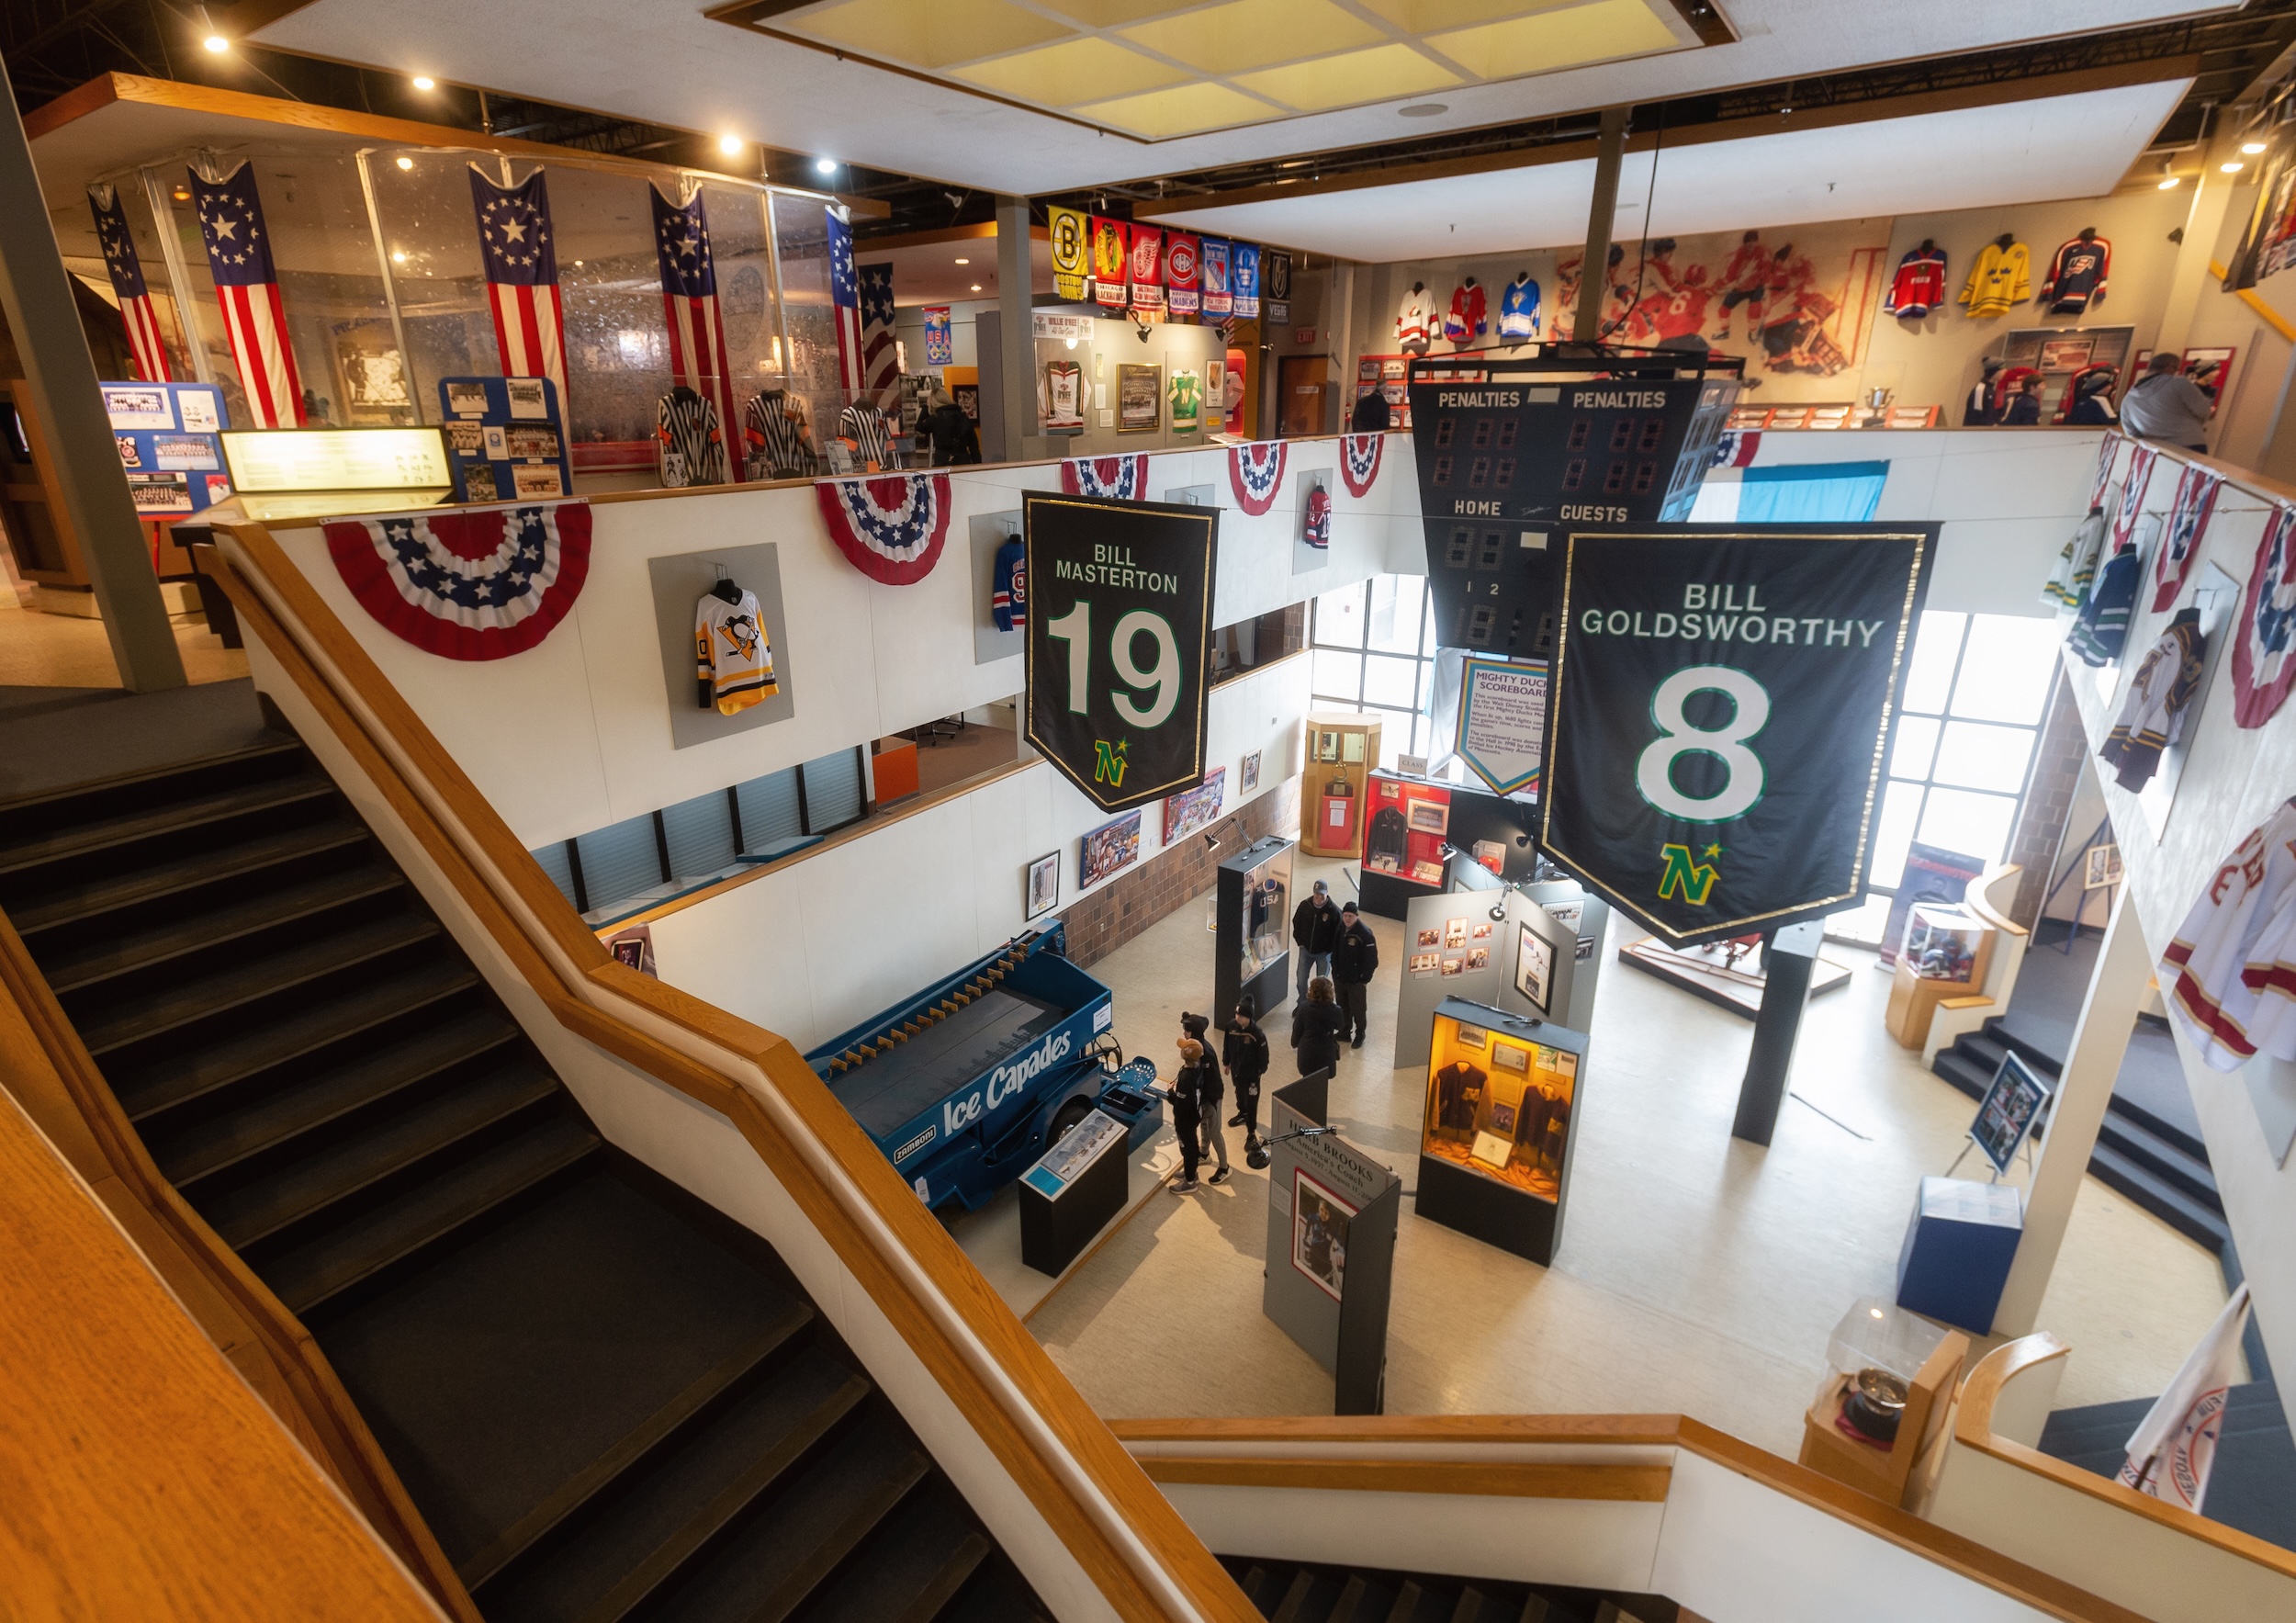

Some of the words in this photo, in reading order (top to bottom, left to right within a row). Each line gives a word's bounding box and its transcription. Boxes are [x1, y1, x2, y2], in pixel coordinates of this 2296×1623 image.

[1063, 224, 1075, 258] B
[1669, 290, 1692, 315] 6
[928, 330, 951, 343] USA
[1299, 332, 1313, 343] EXIT
[1439, 392, 1521, 408] PENALTIES
[1573, 391, 1666, 410] PENALTIES
[1455, 500, 1502, 516] HOME
[1560, 505, 1628, 523] GUESTS
[1095, 544, 1136, 568] BILL
[1056, 560, 1178, 594] MASTERTON
[1490, 583, 1499, 595] 2
[1683, 584, 1767, 613] BILL
[1581, 609, 1885, 648] GOLDSWORTHY
[1048, 599, 1183, 730] 19
[1477, 672, 1517, 683] MIGHTY
[1475, 747, 1502, 755] Minnesota.
[1635, 663, 1773, 825] 8
[1402, 761, 1424, 769] CLASS
[1259, 894, 1279, 907] USA
[943, 1091, 982, 1137] Ice
[985, 1030, 1072, 1110] Capades
[896, 1130, 934, 1160] ZAMBONI
[1289, 1120, 1320, 1147] HRB
[1324, 1143, 1373, 1182] BROOKS
[1297, 1137, 1334, 1168] America's
[1337, 1165, 1364, 1188] Coach
[1329, 1170, 1350, 1188] August
